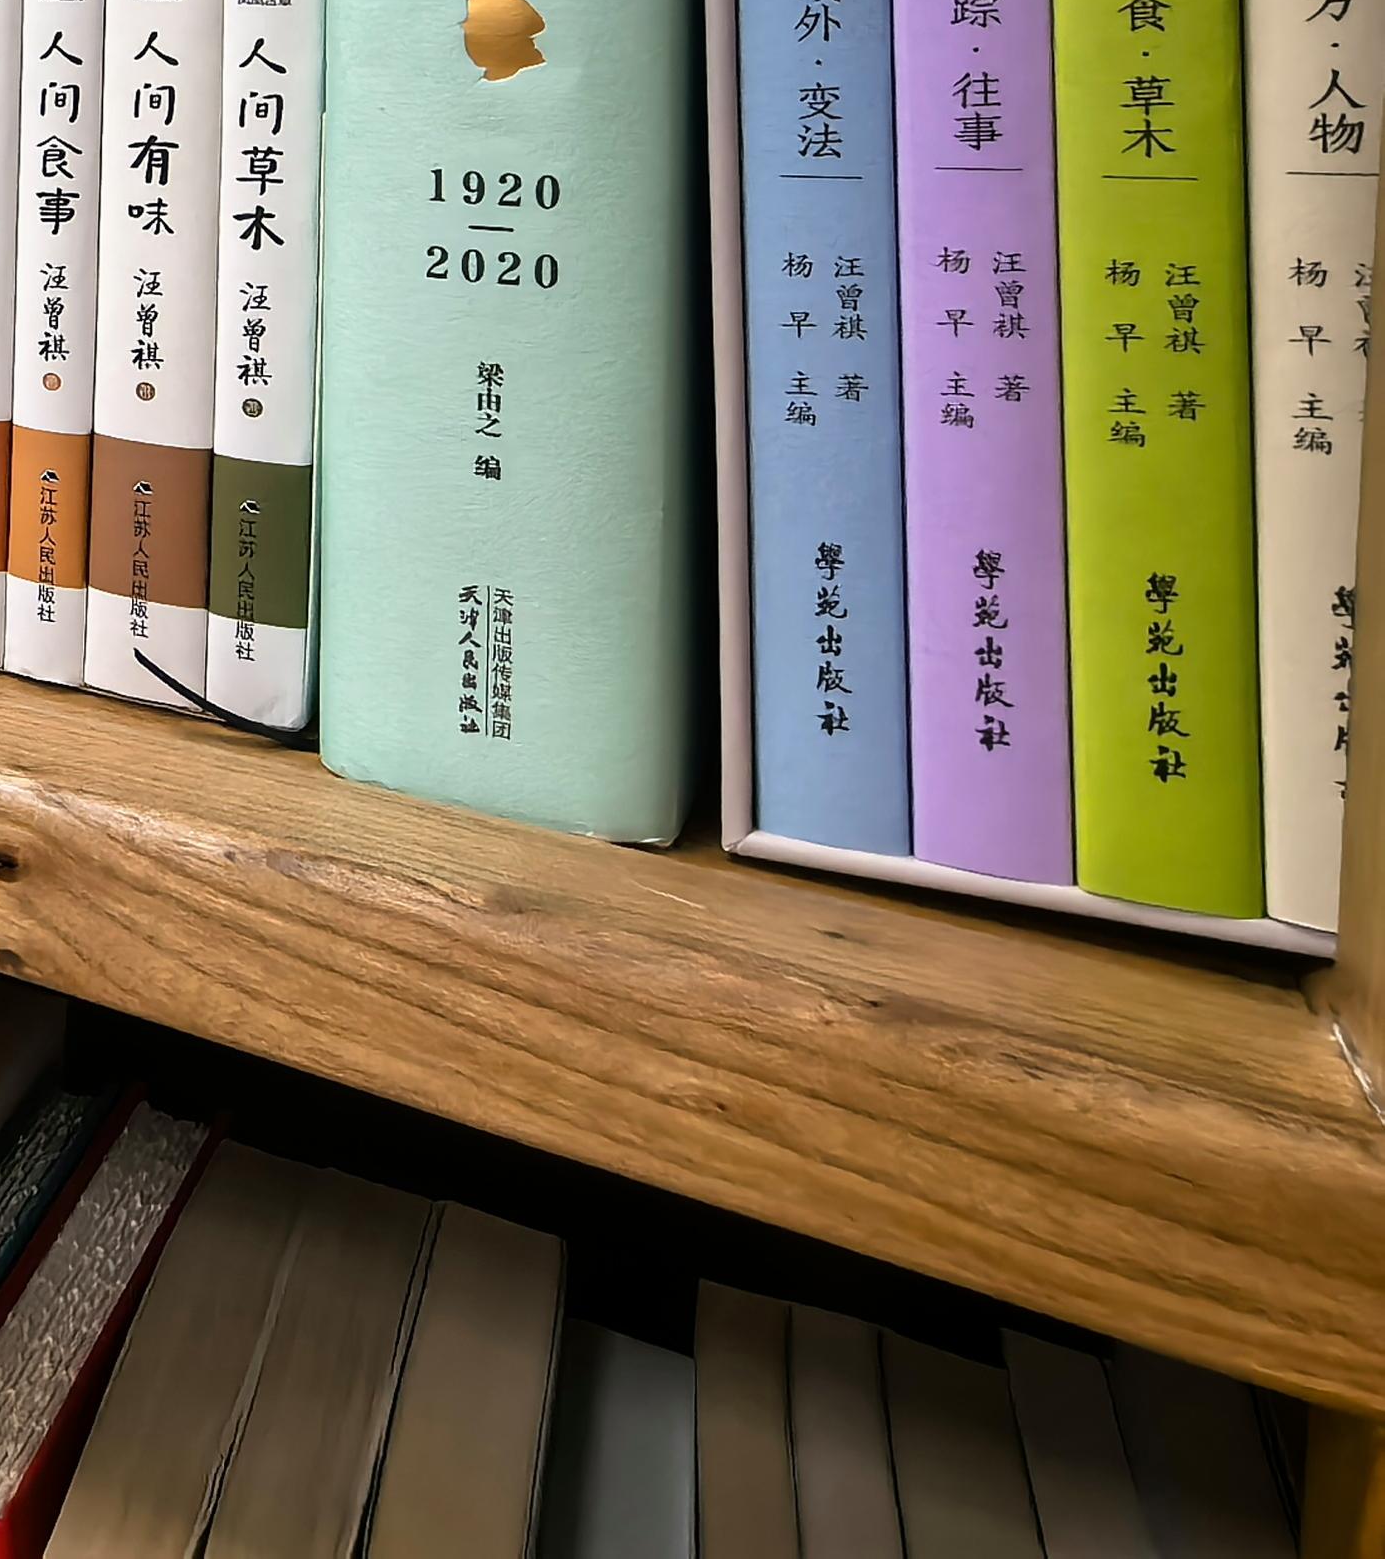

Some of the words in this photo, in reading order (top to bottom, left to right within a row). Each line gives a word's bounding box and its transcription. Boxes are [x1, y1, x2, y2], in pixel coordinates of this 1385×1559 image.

[35, 30, 84, 236] 人间食事
[127, 31, 180, 236] 人间有味
[232, 37, 287, 251] 人间草木
[428, 168, 561, 210] 1920
[37, 262, 71, 362] 汪曾祺
[426, 245, 559, 290] 2020
[781, 251, 818, 335] 杨早
[832, 255, 869, 341] 汪曾祺
[934, 246, 975, 337] 杨早
[992, 250, 1031, 340] 汪曾祺
[1104, 258, 1146, 353] 杨早
[1164, 262, 1206, 355] 汪曾祺
[1288, 257, 1332, 357] 杨早
[130, 268, 165, 371] 汪曾祺
[236, 281, 273, 387] 汪曾祺
[474, 361, 505, 438] 梁由之
[784, 370, 819, 427] 主编
[834, 373, 870, 403] 著
[939, 370, 976, 429] 主编
[994, 374, 1031, 403] 著
[1107, 387, 1147, 448] 主编
[1168, 390, 1206, 422] 著
[1292, 392, 1334, 456] 主编
[473, 454, 502, 481] 编
[35, 484, 59, 626] 江苏人民出版社
[125, 496, 153, 642] 江苏人民出版社
[233, 514, 259, 664] 江苏人民出版社
[491, 587, 515, 741] 天津出版传媒集团
